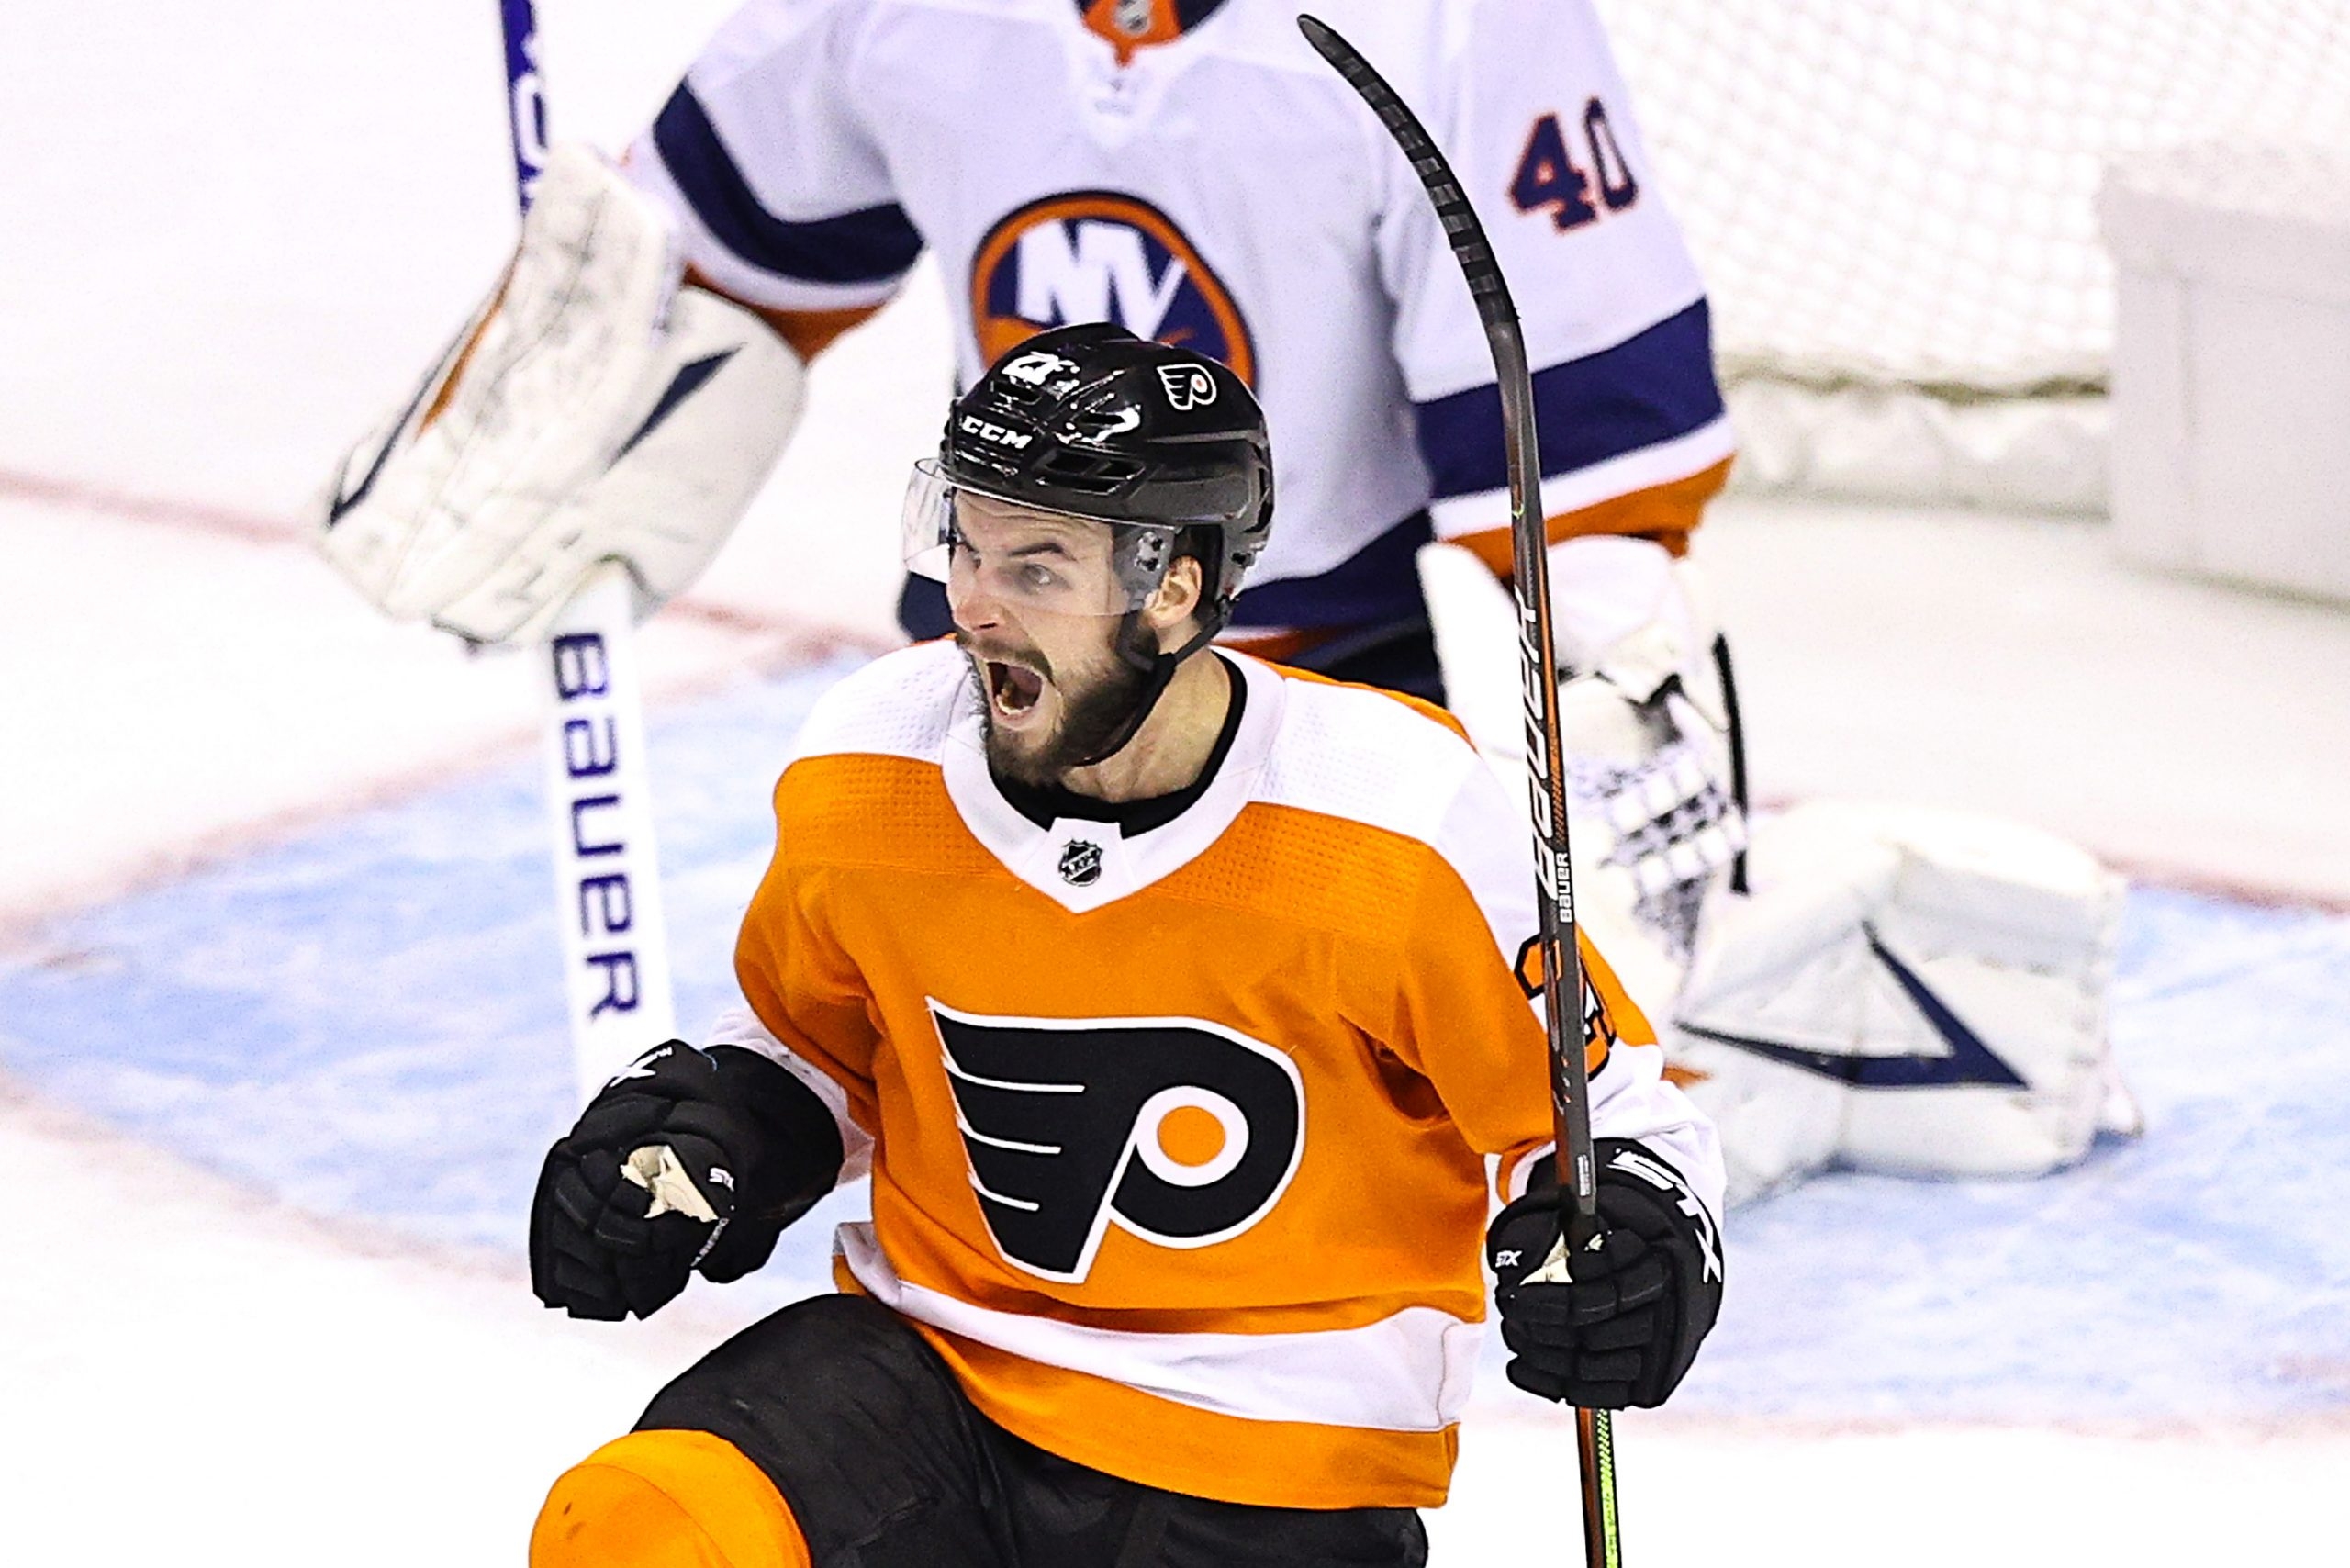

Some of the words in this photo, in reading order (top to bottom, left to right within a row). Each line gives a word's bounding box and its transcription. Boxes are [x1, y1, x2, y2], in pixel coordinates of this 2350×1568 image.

[1508, 96, 1639, 233] 40
[962, 415, 1033, 449] CCM
[1495, 1249, 1522, 1268] STX
